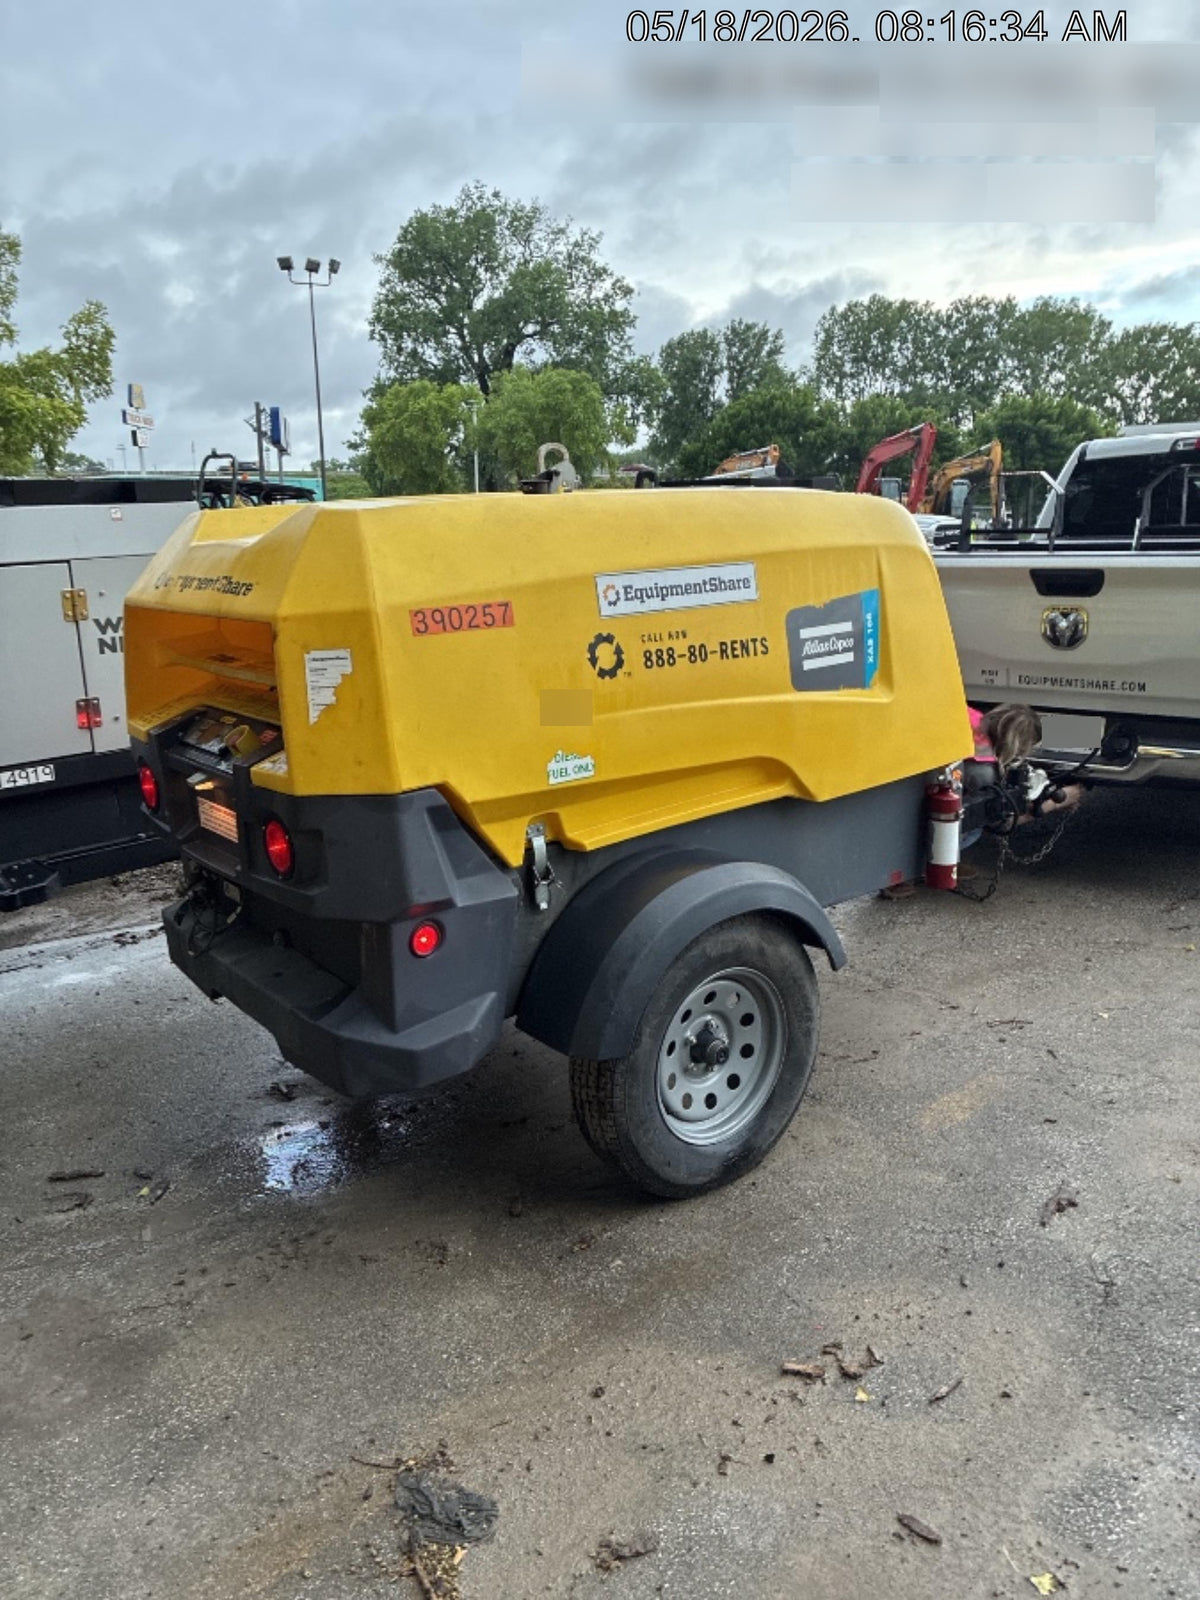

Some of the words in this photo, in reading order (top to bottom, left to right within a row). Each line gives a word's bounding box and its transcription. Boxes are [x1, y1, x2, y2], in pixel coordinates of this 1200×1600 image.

[622, 576, 751, 604] EquipmentShare
[93, 616, 124, 635] W
[413, 602, 509, 634] 390257
[641, 632, 664, 643] CALL
[668, 630, 688, 641] NOW
[643, 637, 769, 669] 888-80-RENTS
[1018, 674, 1146, 692] EQUIPMENTSHARE.COM
